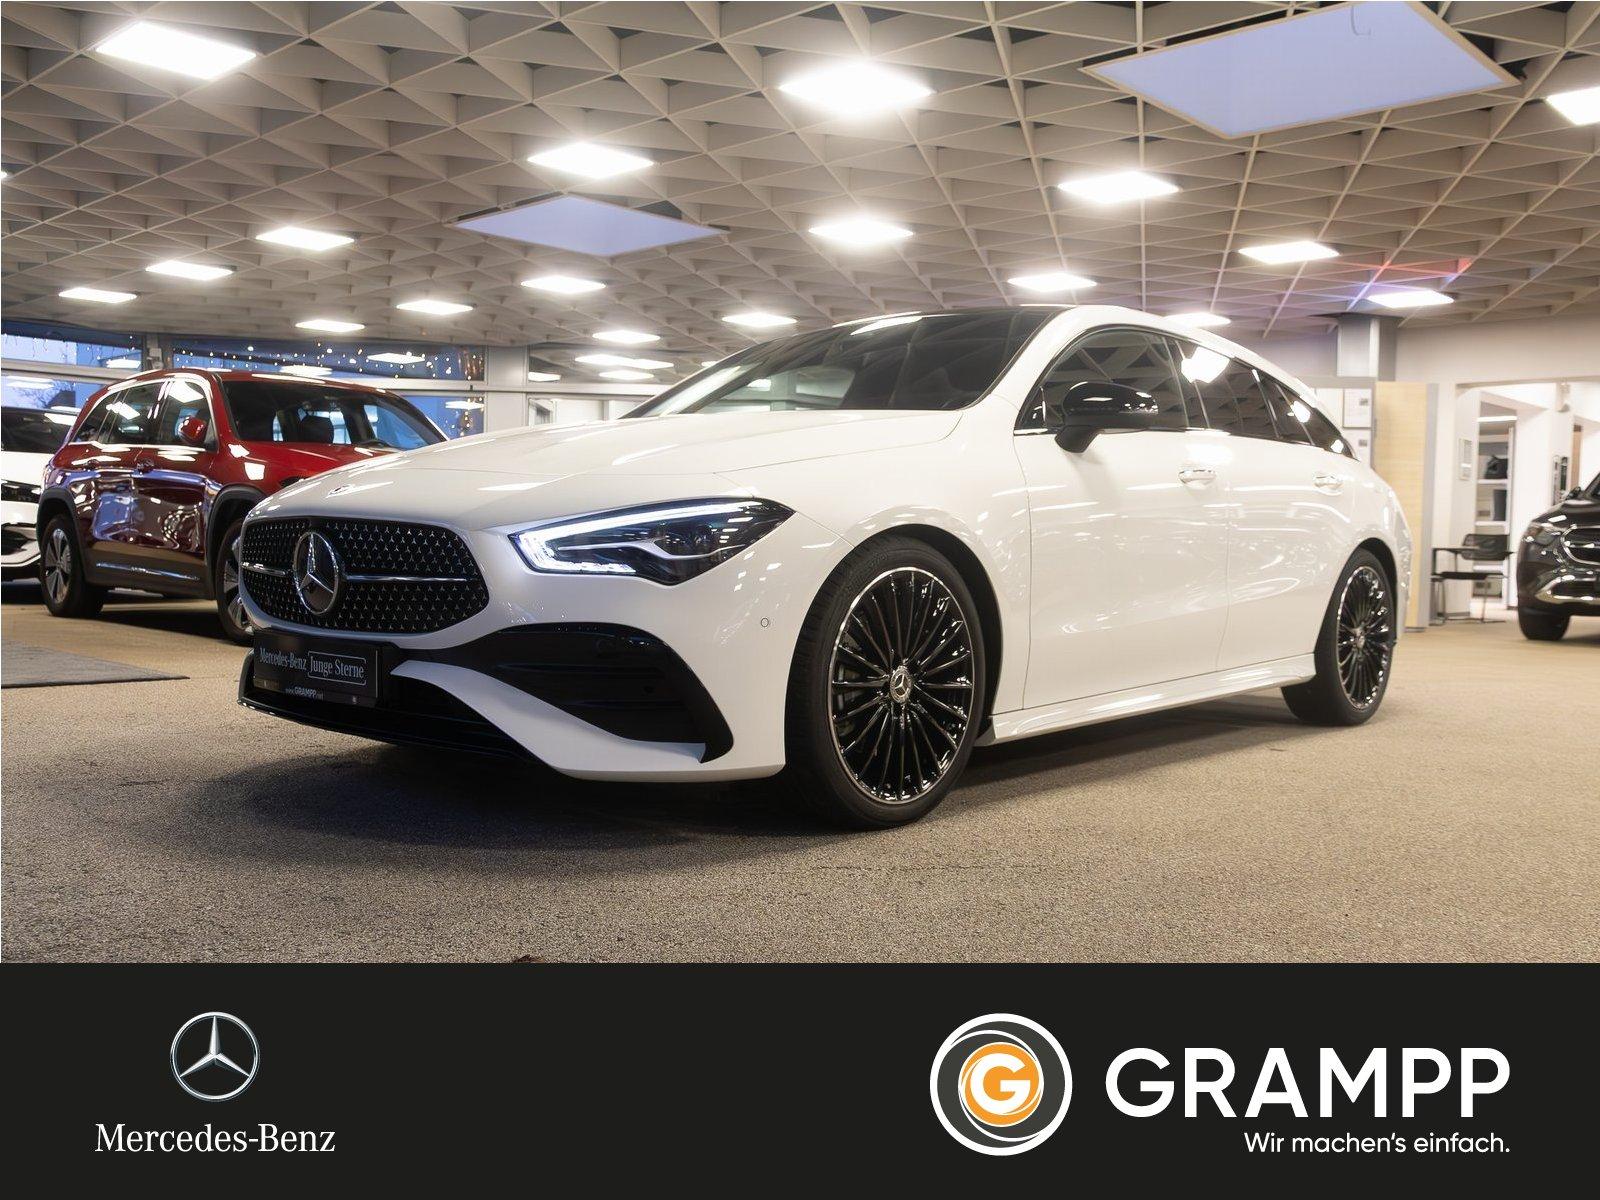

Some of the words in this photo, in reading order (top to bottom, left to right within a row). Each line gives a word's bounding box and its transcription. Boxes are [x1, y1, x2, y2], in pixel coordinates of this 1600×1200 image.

[259, 647, 307, 670] Mercedes-Benz
[310, 655, 333, 677] Junge
[334, 658, 364, 679] Sterne
